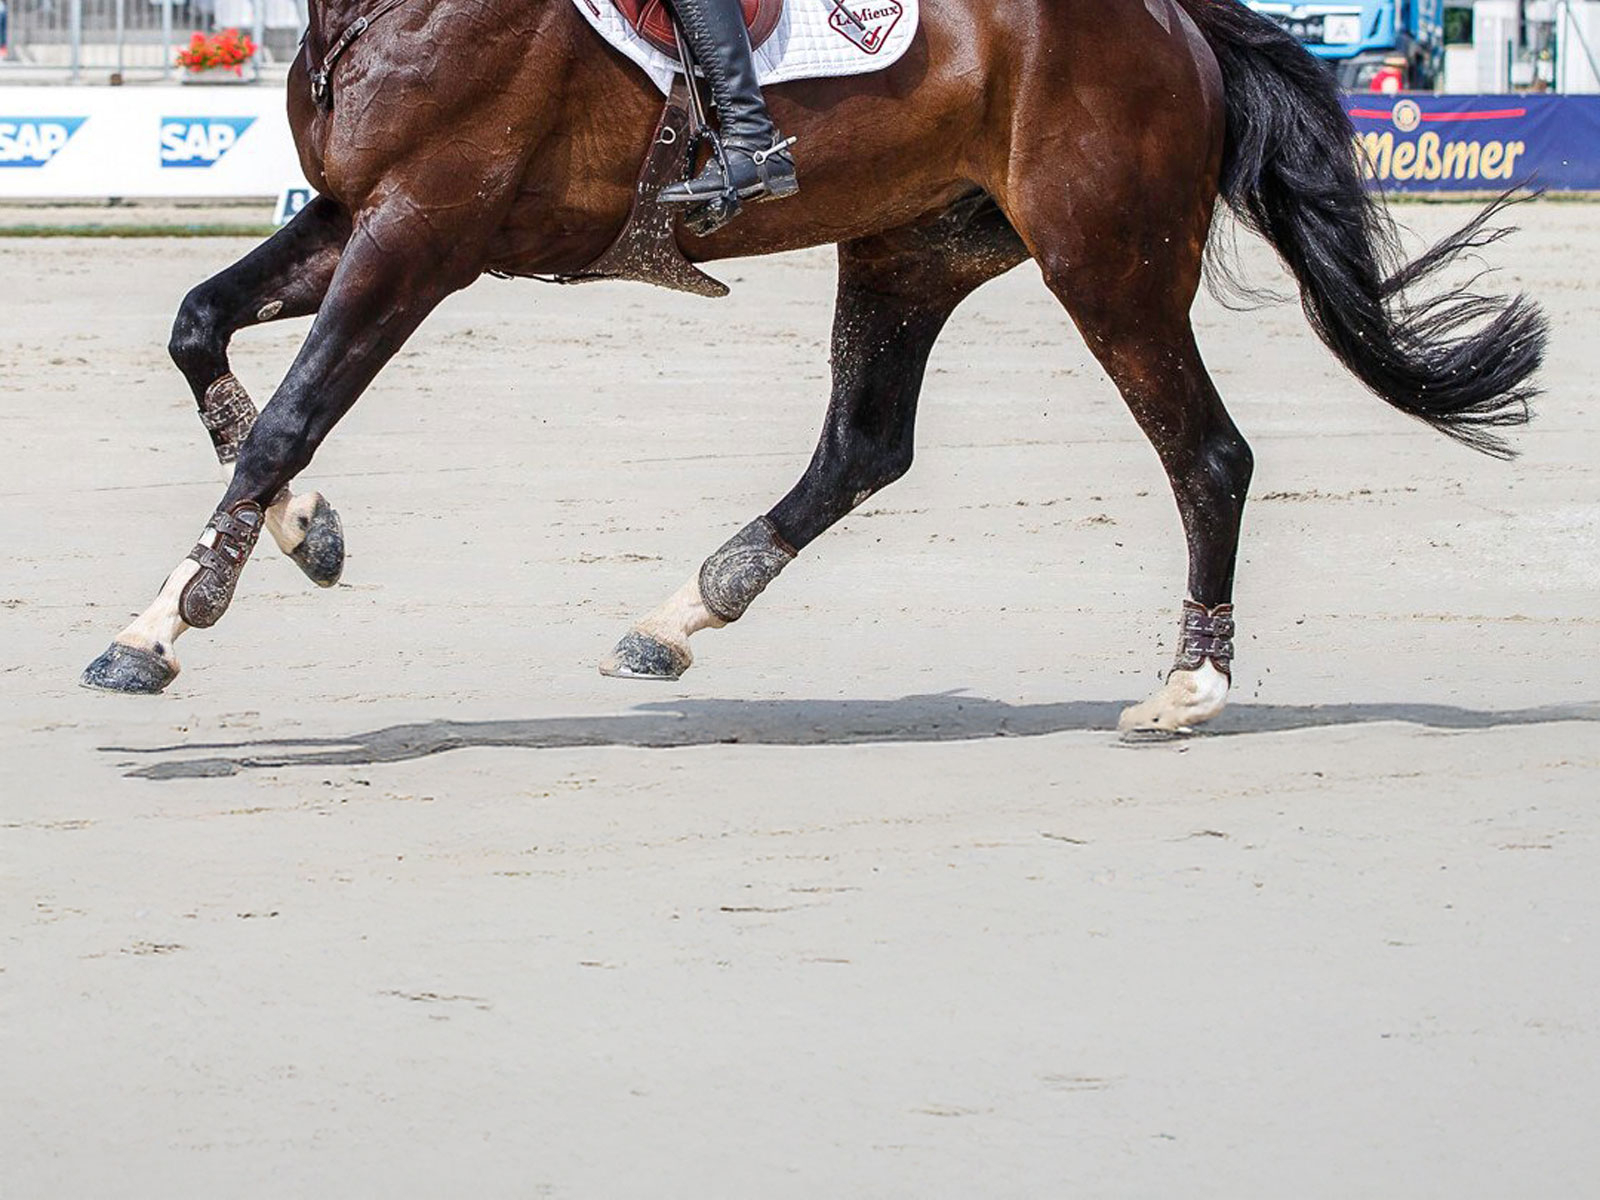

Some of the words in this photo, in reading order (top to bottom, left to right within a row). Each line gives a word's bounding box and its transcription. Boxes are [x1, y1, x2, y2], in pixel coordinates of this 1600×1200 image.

[0, 123, 67, 161] SAP
[161, 123, 236, 161] SAP
[1351, 131, 1525, 180] Meßmer
